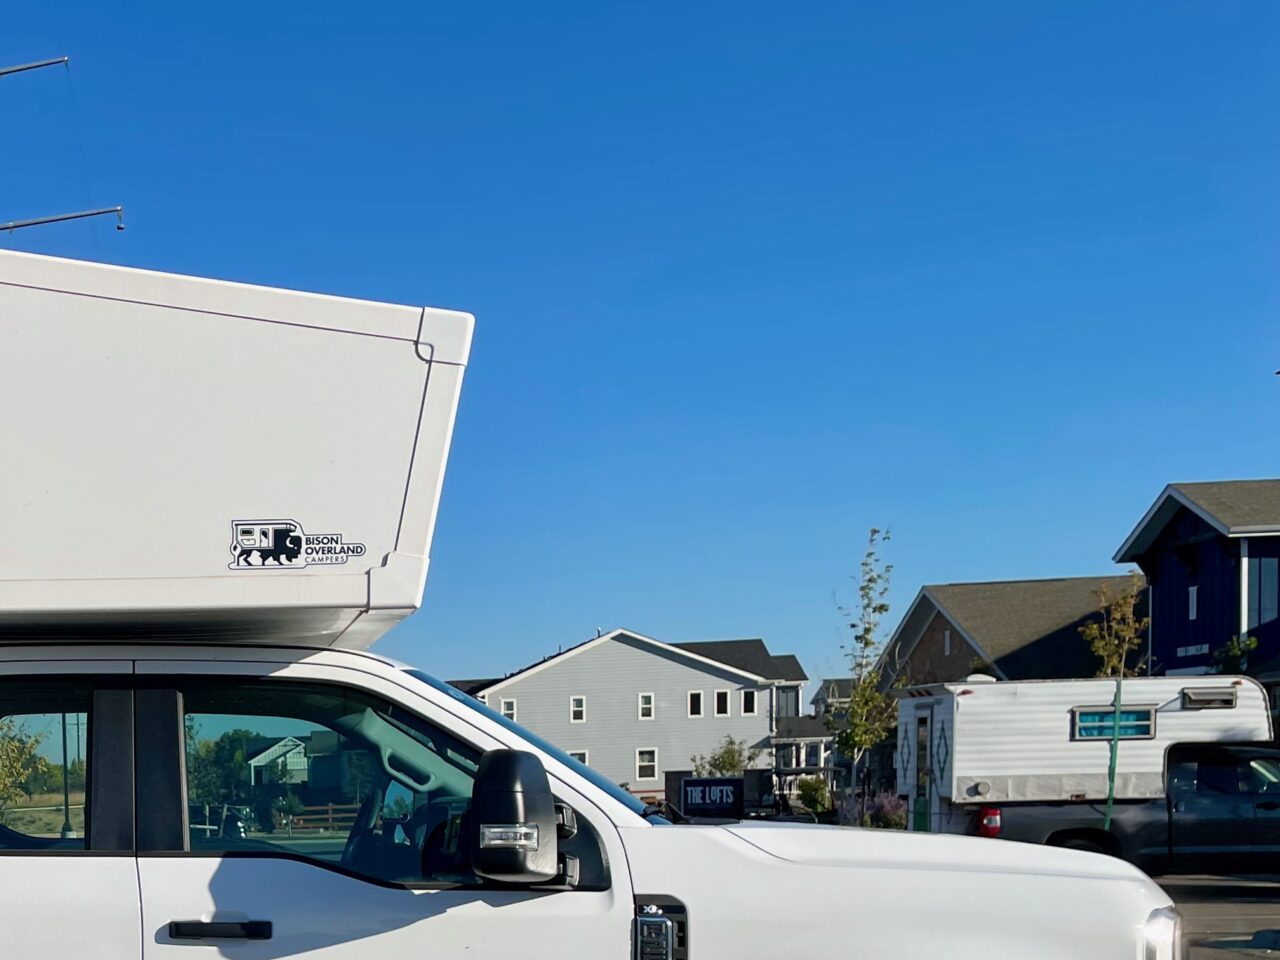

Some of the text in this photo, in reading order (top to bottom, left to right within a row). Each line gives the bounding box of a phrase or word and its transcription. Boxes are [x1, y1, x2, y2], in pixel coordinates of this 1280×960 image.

[305, 536, 339, 546] BISON
[305, 545, 363, 555] OVERLAND
[304, 555, 345, 563] CAMPERS
[686, 785, 734, 804] THE LOFTS
